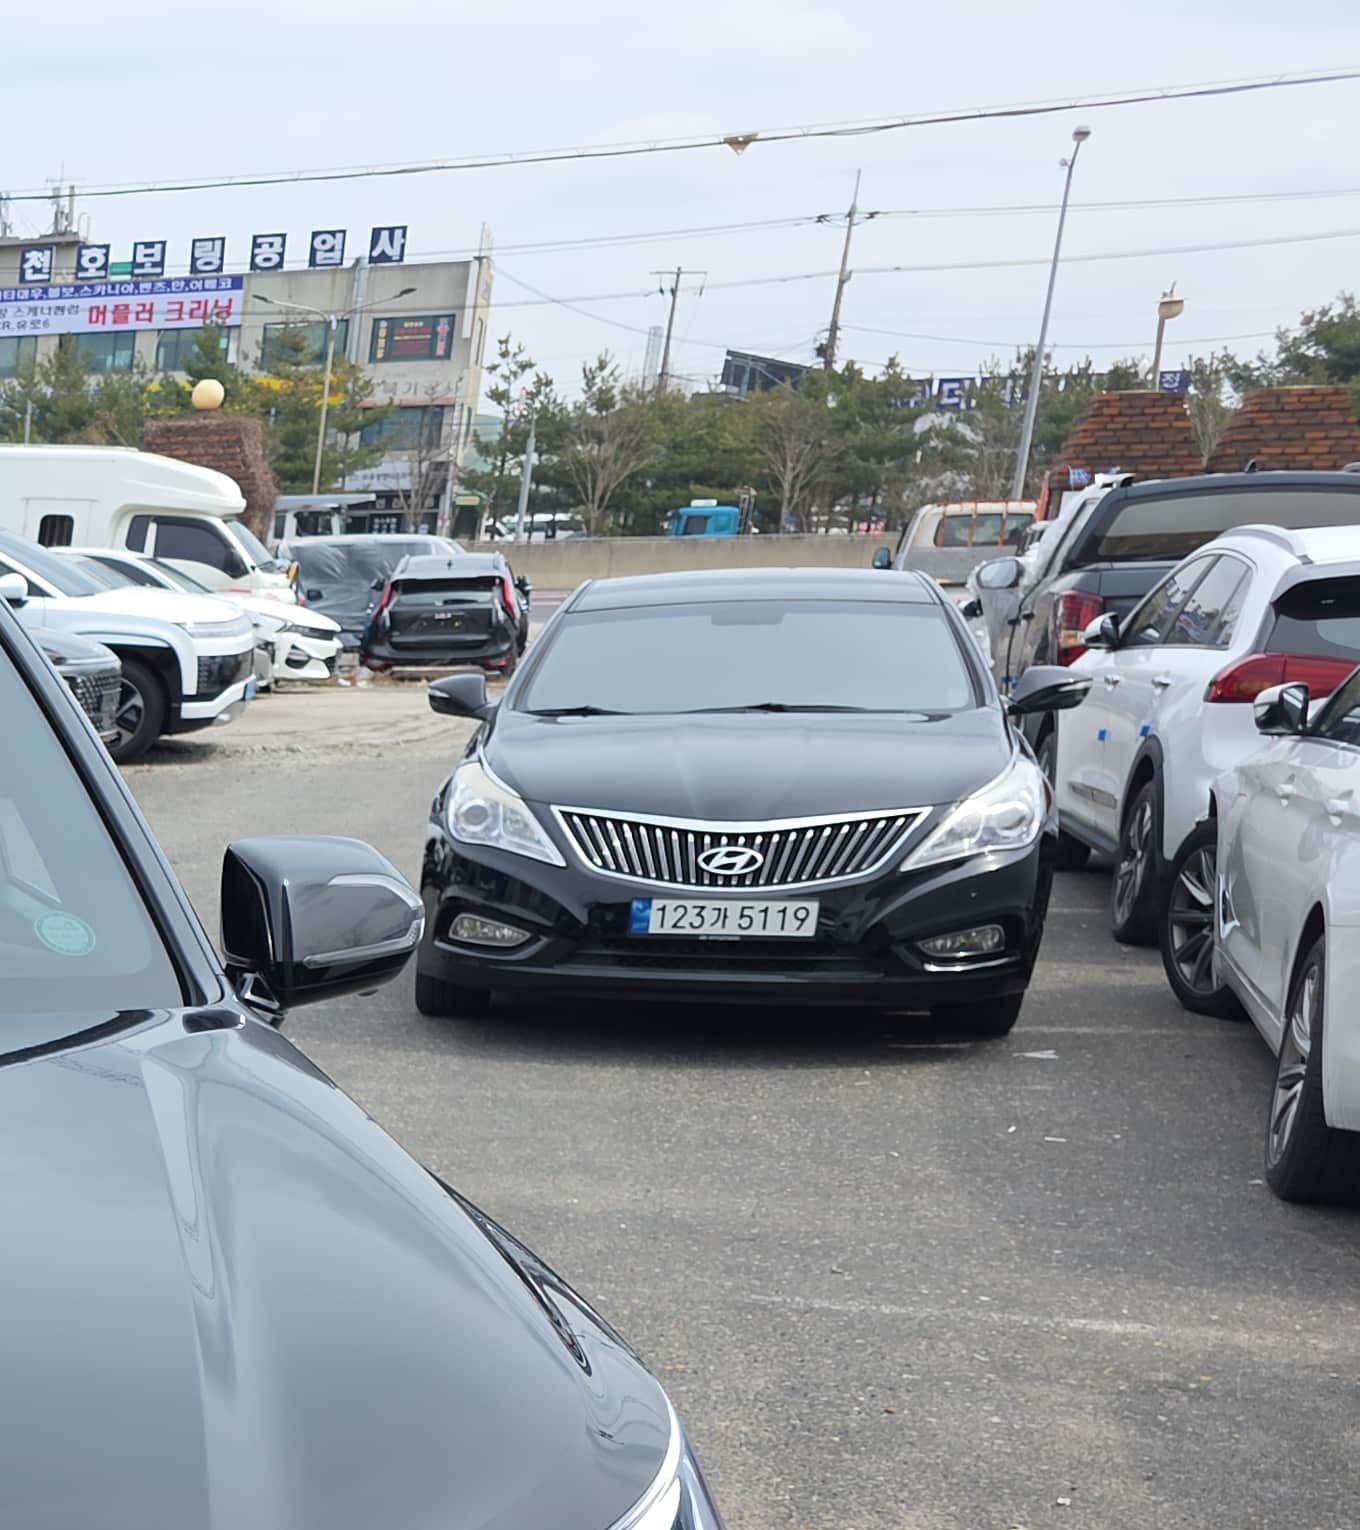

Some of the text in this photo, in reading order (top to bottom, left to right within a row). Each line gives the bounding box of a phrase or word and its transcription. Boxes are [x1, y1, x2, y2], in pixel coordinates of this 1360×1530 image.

[88, 302, 155, 326] 머플러
[656, 904, 811, 931] 123가 5119
